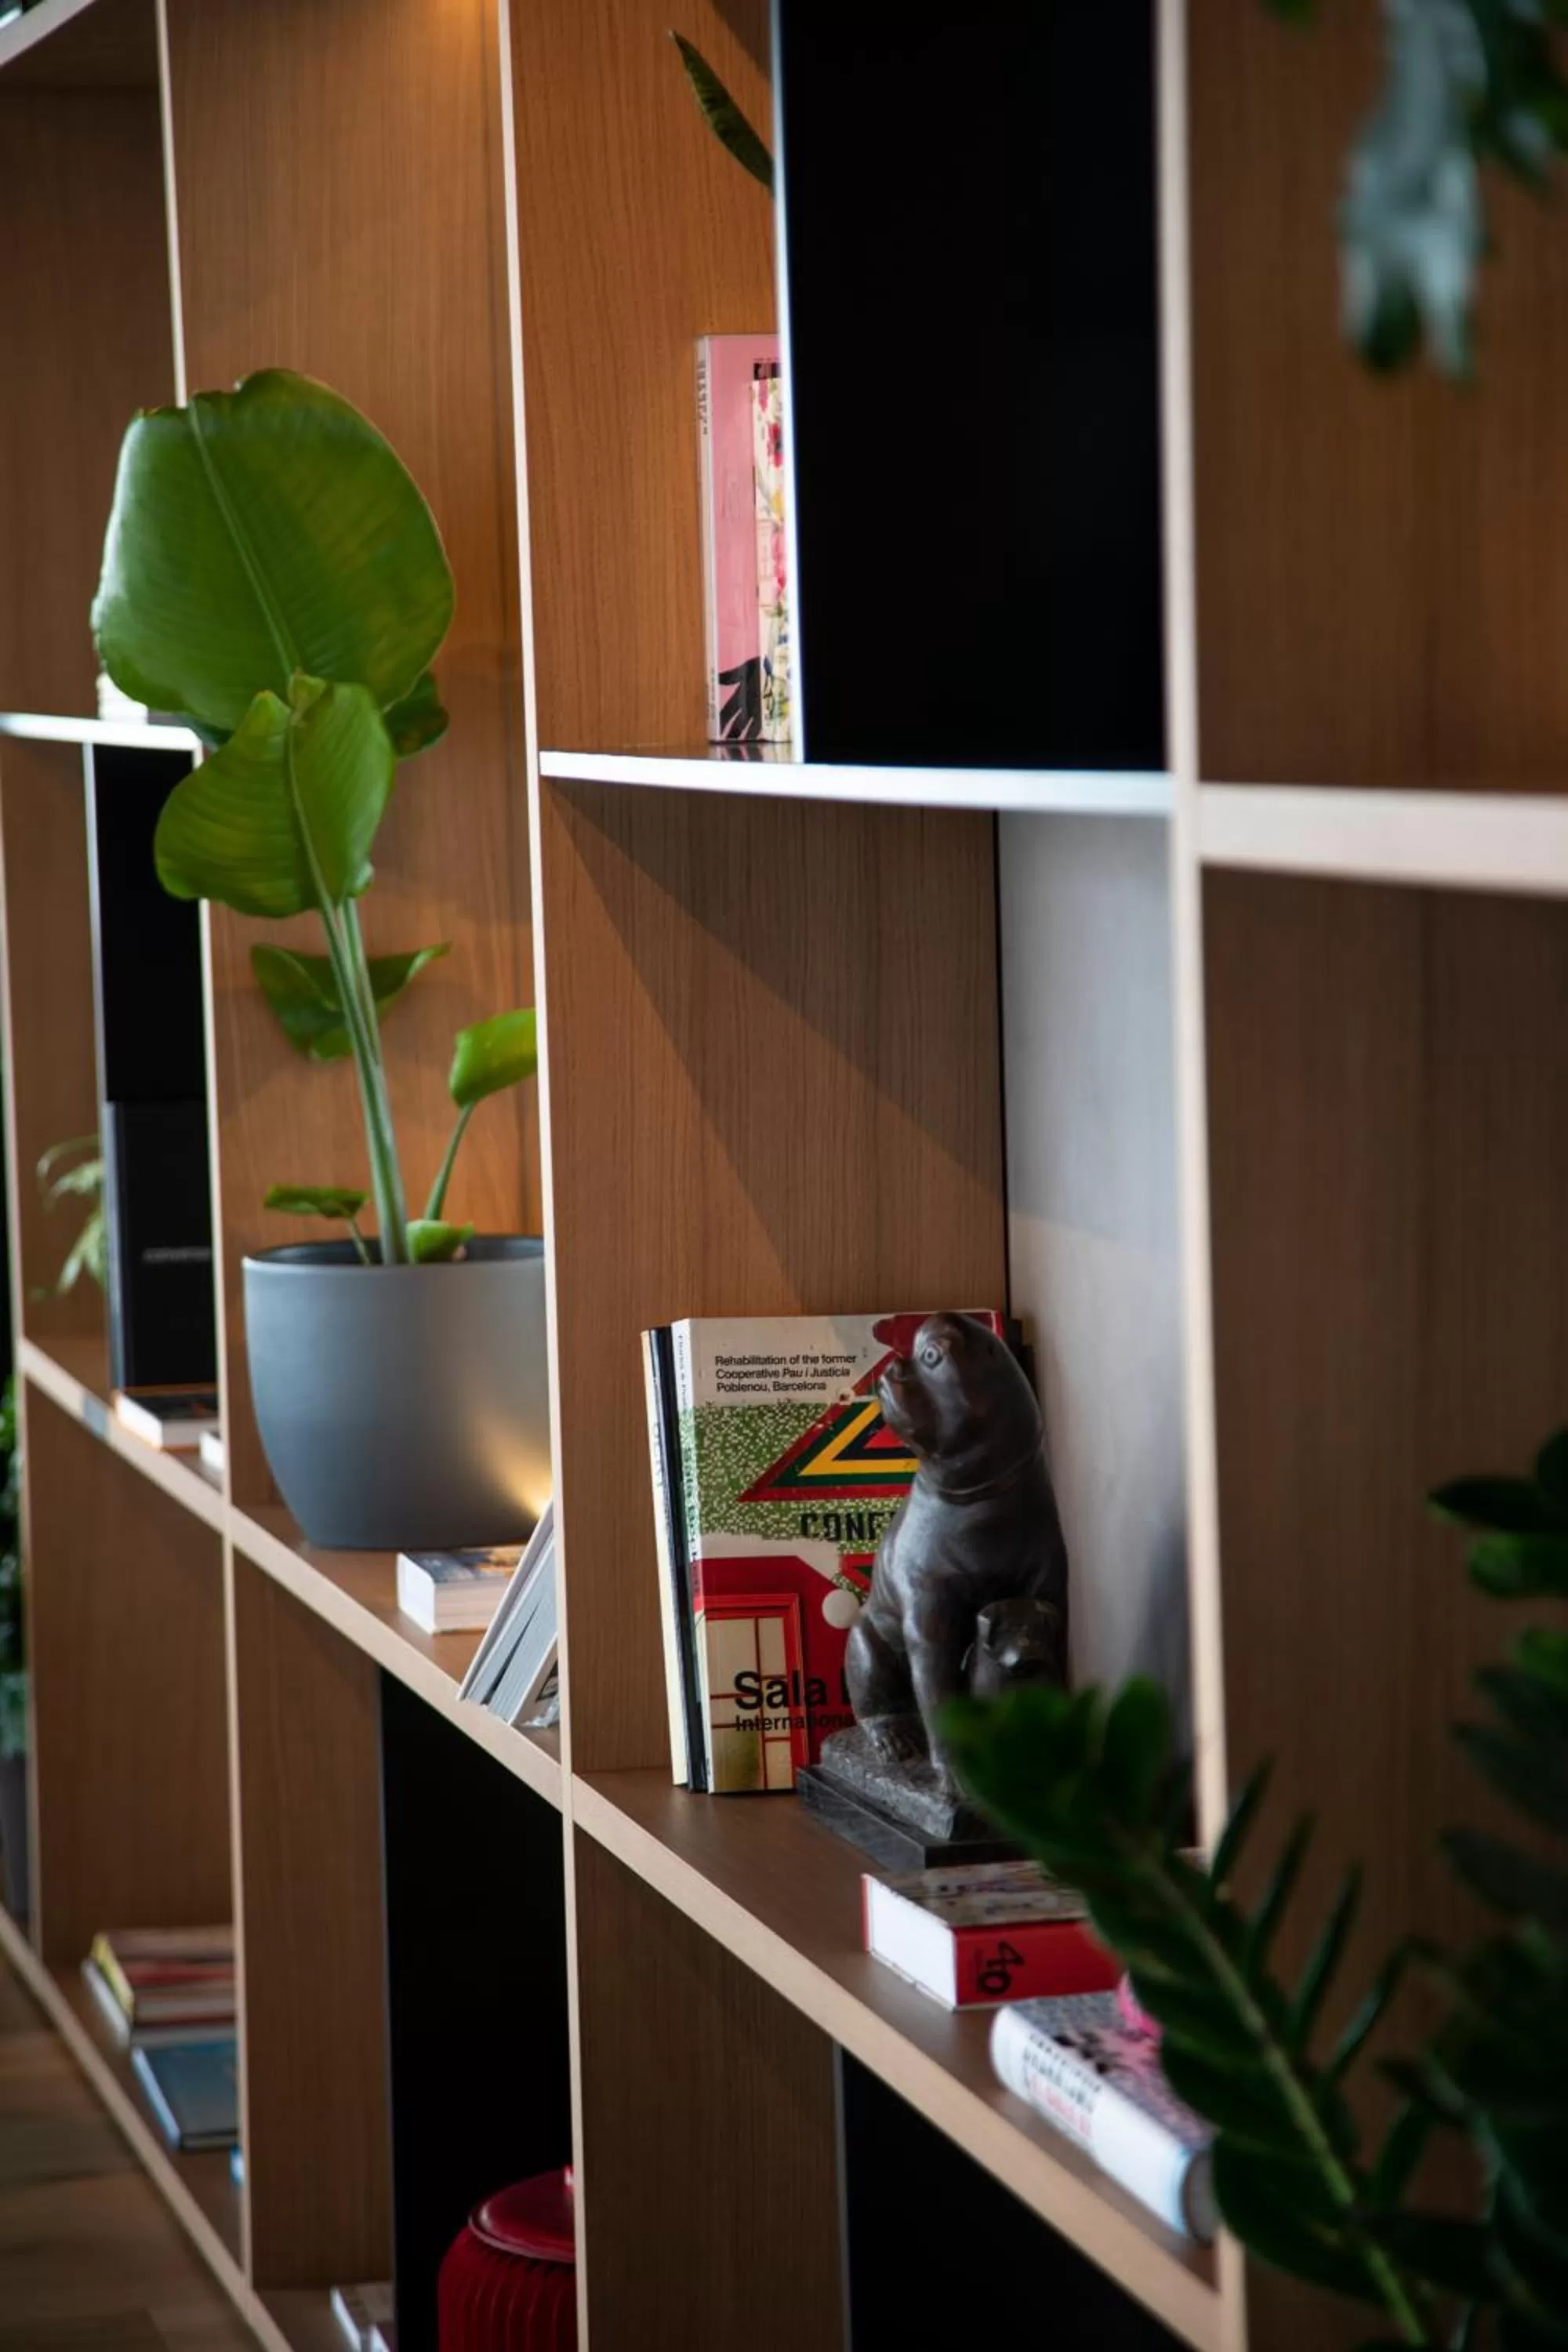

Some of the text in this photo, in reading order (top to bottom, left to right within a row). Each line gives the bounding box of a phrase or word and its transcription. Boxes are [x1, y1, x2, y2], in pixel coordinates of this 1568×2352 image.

[715, 1354, 856, 1366] Rehabilitation of the former
[716, 1368, 780, 1381] Cooperative
[782, 1368, 803, 1377] Pau
[717, 1381, 826, 1392] Poblenou, Barcelona
[800, 1511, 895, 1541] CONF
[734, 1669, 827, 1710] Sala
